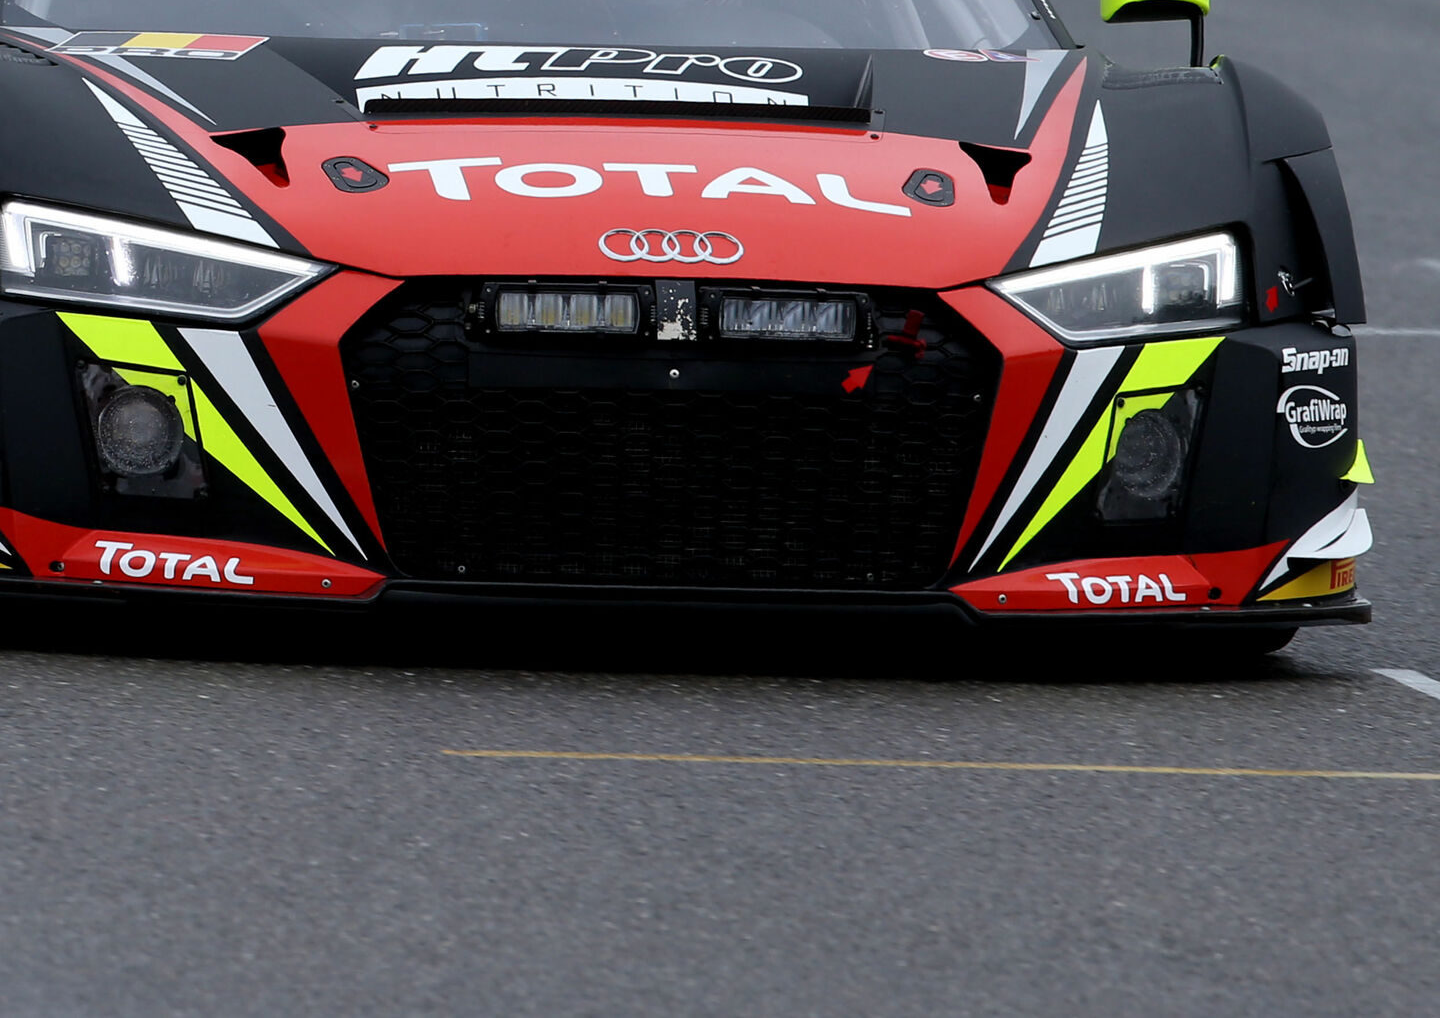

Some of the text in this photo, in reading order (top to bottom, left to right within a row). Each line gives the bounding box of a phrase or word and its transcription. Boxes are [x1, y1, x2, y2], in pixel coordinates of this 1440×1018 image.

[387, 156, 912, 217] TOTAL
[1282, 348, 1349, 374] Snap-on
[1285, 398, 1347, 425] GrafiWrap
[95, 540, 254, 585] TOTAL
[1045, 572, 1186, 604] TOTAL
